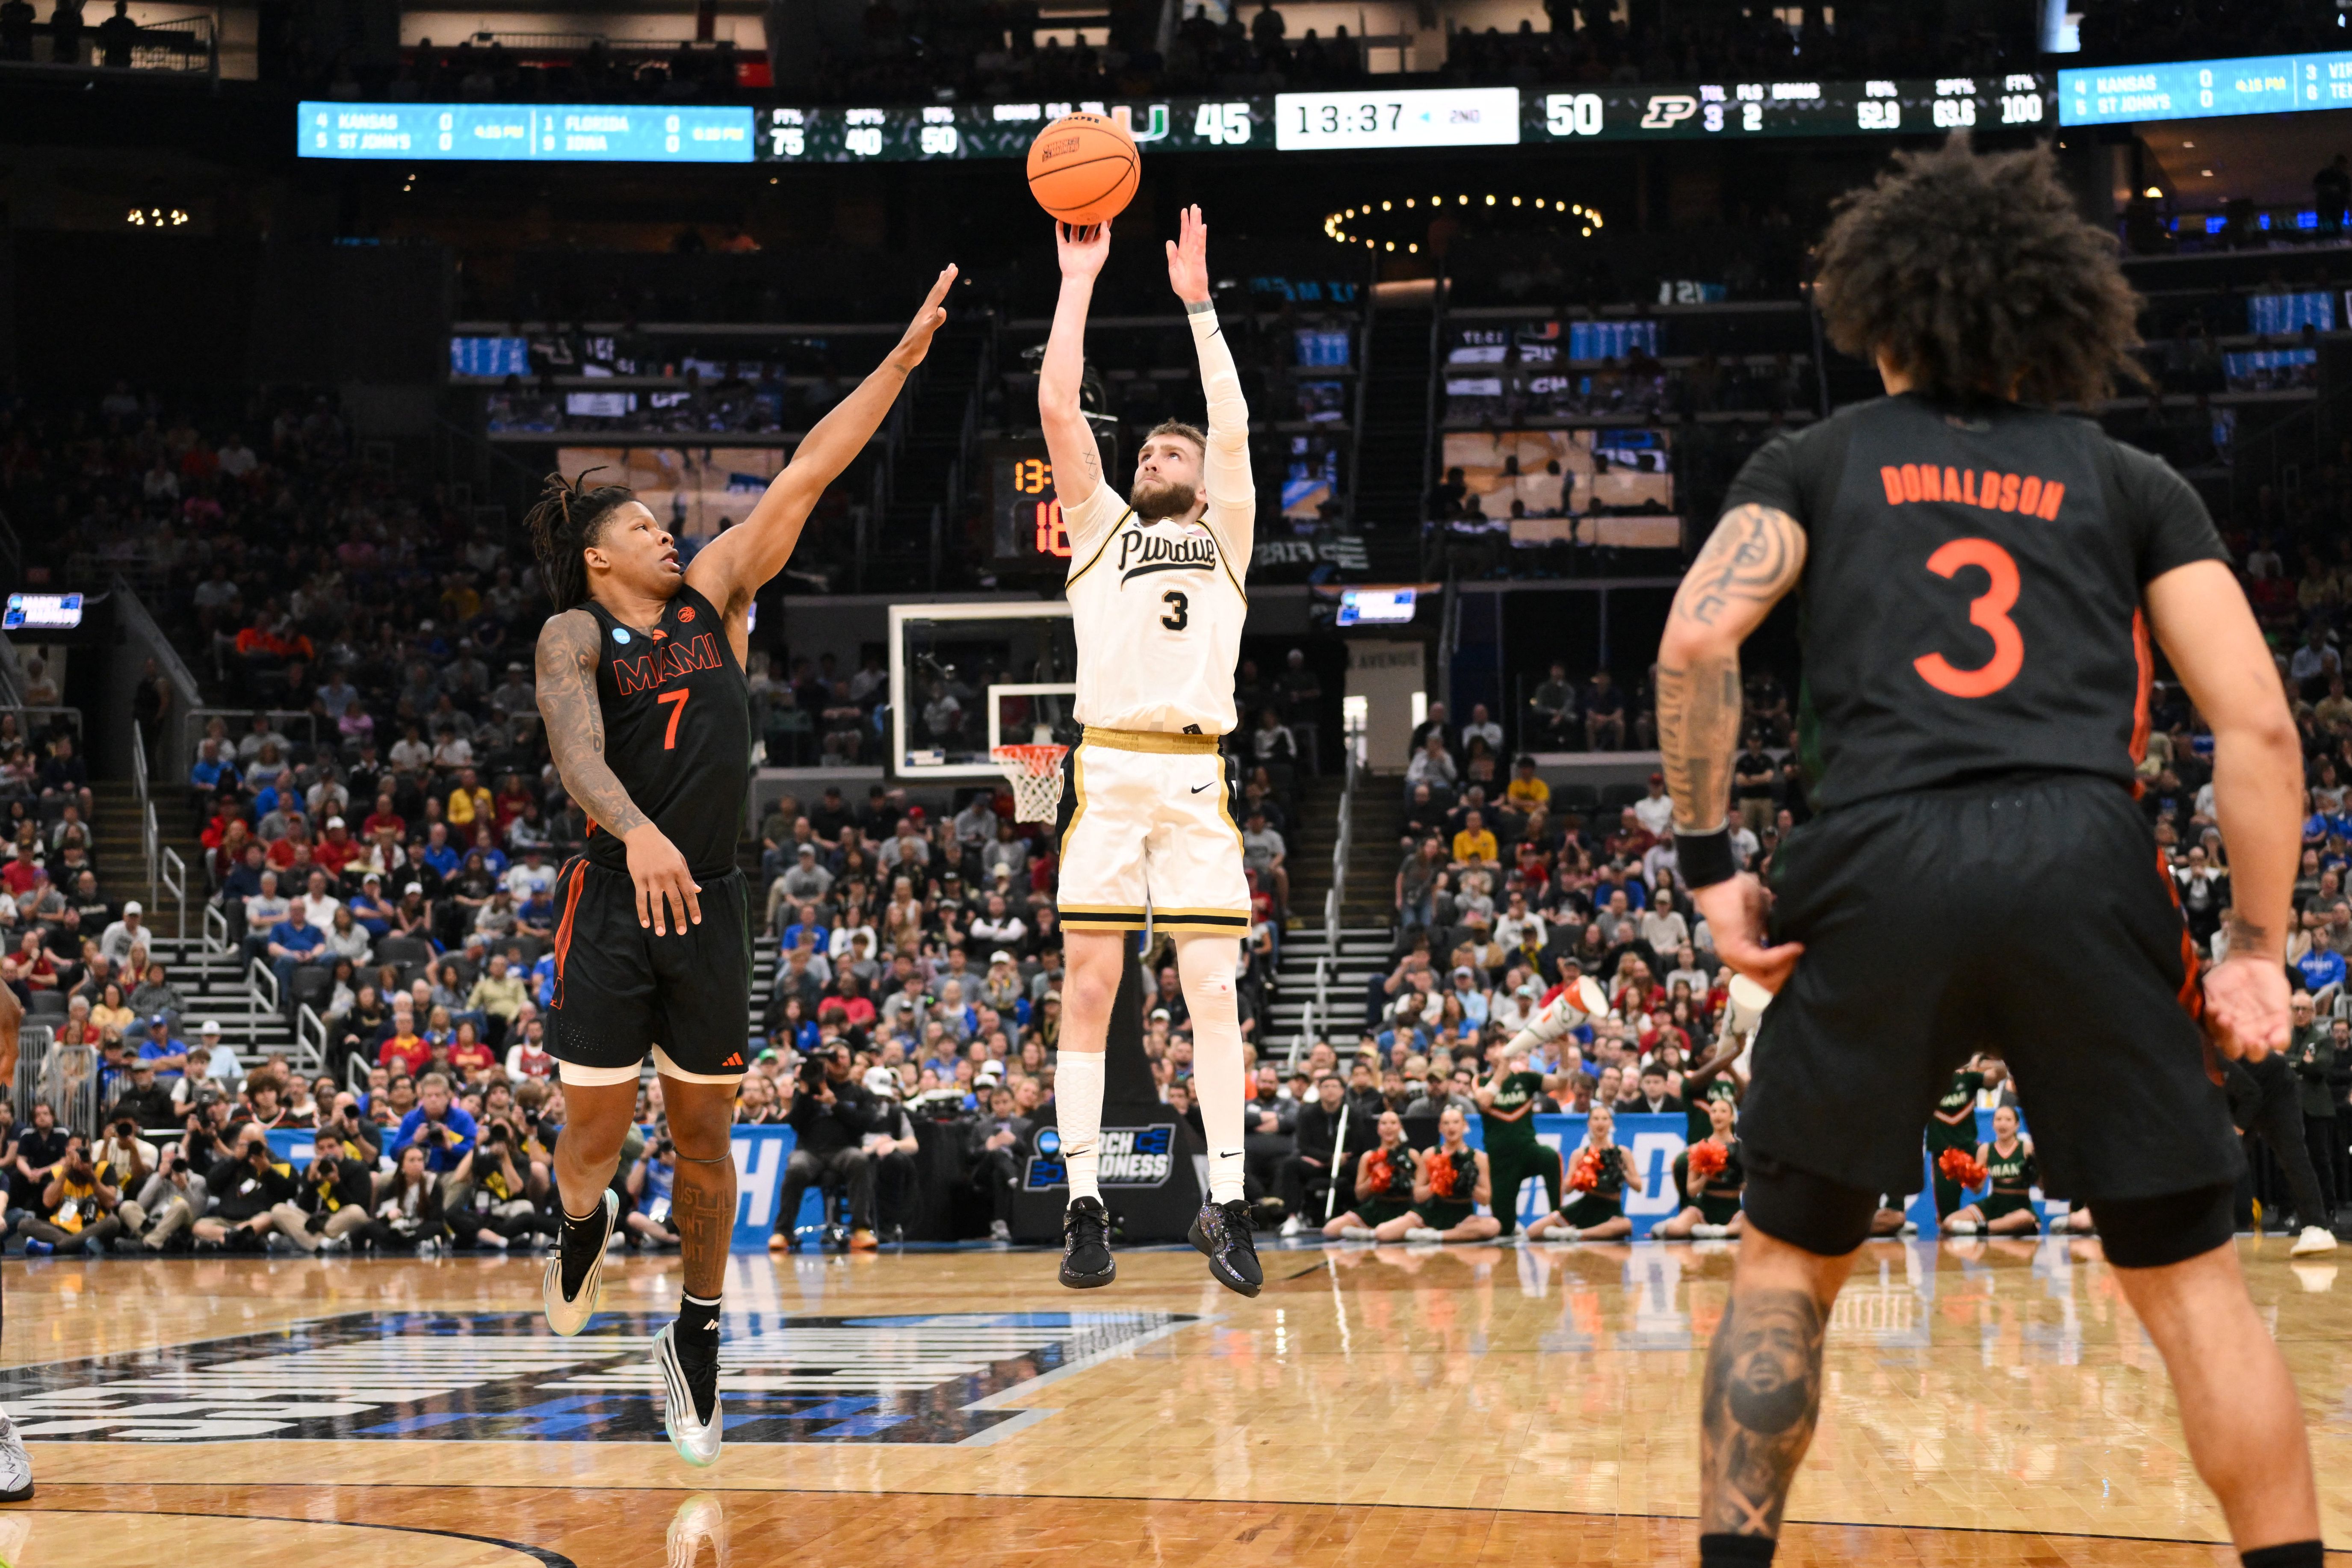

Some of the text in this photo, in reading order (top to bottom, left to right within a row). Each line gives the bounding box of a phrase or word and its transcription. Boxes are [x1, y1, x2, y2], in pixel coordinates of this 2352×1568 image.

[2075, 68, 2212, 96] 4 KANSAS 0
[2266, 77, 2286, 91] PM
[2306, 64, 2317, 80] 3
[2076, 89, 2213, 115] 5 ST JOHN'S 0
[2307, 84, 2318, 100] 6
[316, 112, 453, 131] 4 KANSAS 0
[1298, 104, 1402, 133] 13:37
[1450, 109, 1480, 124] 2ND
[1546, 93, 1603, 136] 50
[1704, 103, 1762, 132] 3 2
[2001, 94, 2042, 124] 100
[504, 125, 524, 139] PM
[544, 115, 680, 133] 1 FLORIDA 0
[1194, 103, 1250, 145] 45
[316, 132, 453, 151] 5 ST JOHN'S 0
[543, 134, 680, 153] 9 IOWA 0
[770, 128, 804, 155] 75
[845, 128, 882, 156] 40
[921, 126, 957, 154] 50
[1880, 463, 2065, 522] DONALDSON
[1117, 530, 1216, 571] Purdue
[1159, 589, 1188, 632] 3
[1913, 537, 2024, 698] 3
[657, 688, 690, 750] 7
